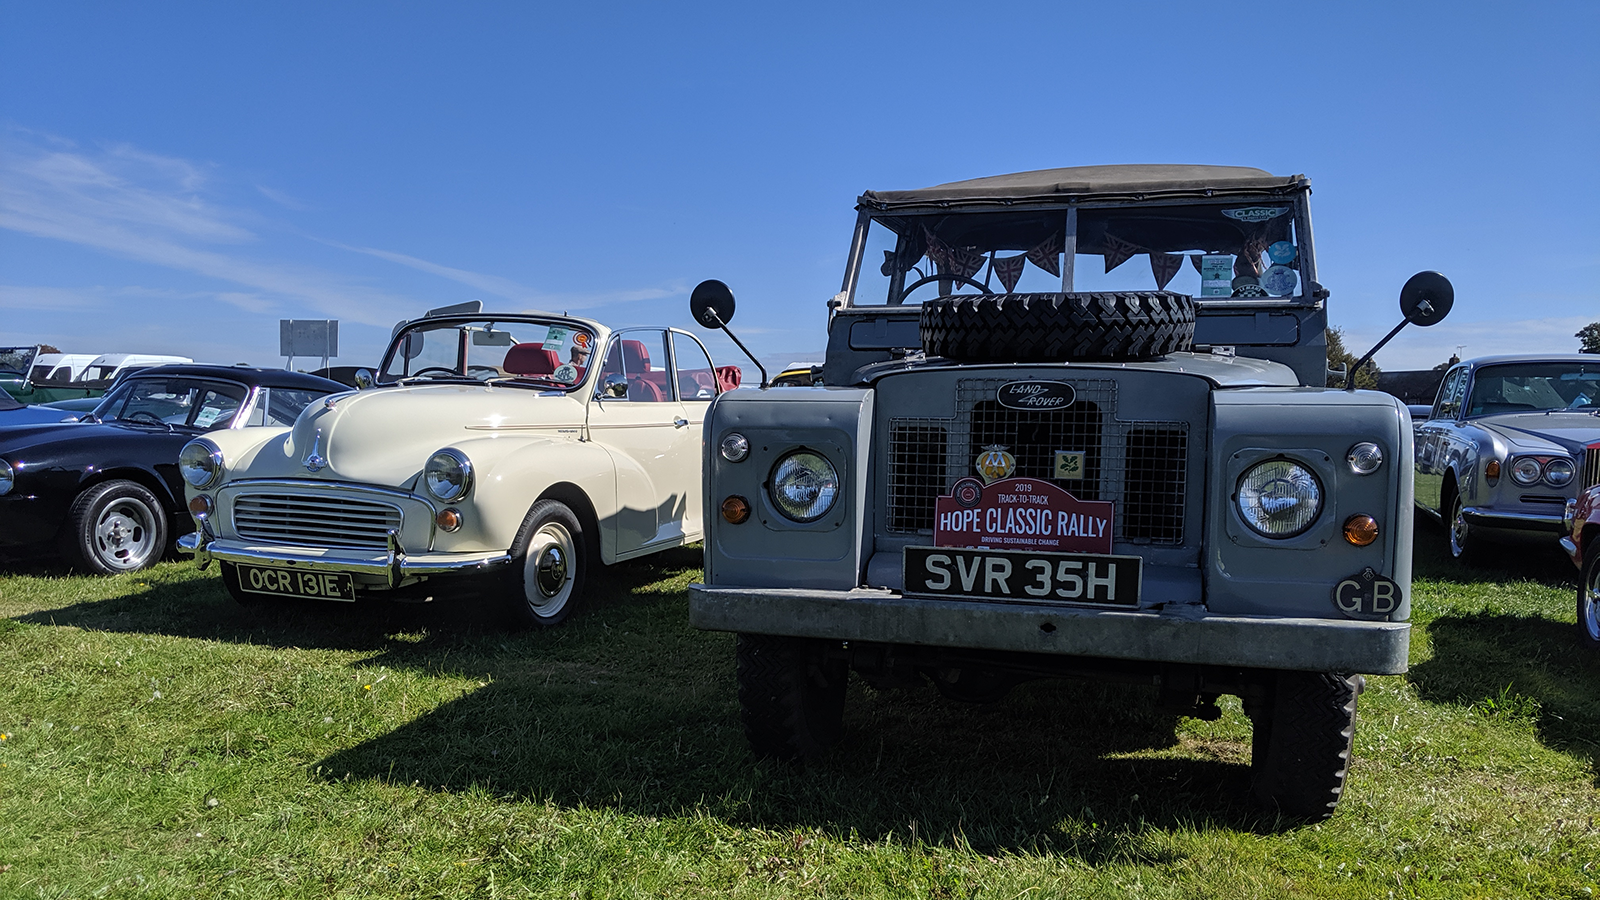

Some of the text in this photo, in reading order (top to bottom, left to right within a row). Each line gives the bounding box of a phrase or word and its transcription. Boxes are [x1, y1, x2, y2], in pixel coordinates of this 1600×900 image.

[1235, 209, 1276, 217] CLASSIC
[1009, 384, 1041, 394] LAND
[1026, 397, 1064, 406] ROVER
[1014, 483, 1032, 492] 2019
[997, 493, 1049, 505] TRACK-TO-TRACK
[940, 507, 1107, 538] HOPE CLASSIC RALLY
[981, 536, 1060, 547] DRIVING SUSTAINABLE CHANGE
[249, 568, 341, 597] OCR 131E
[925, 554, 1116, 600] SVR 35H
[1336, 580, 1395, 613] GB
